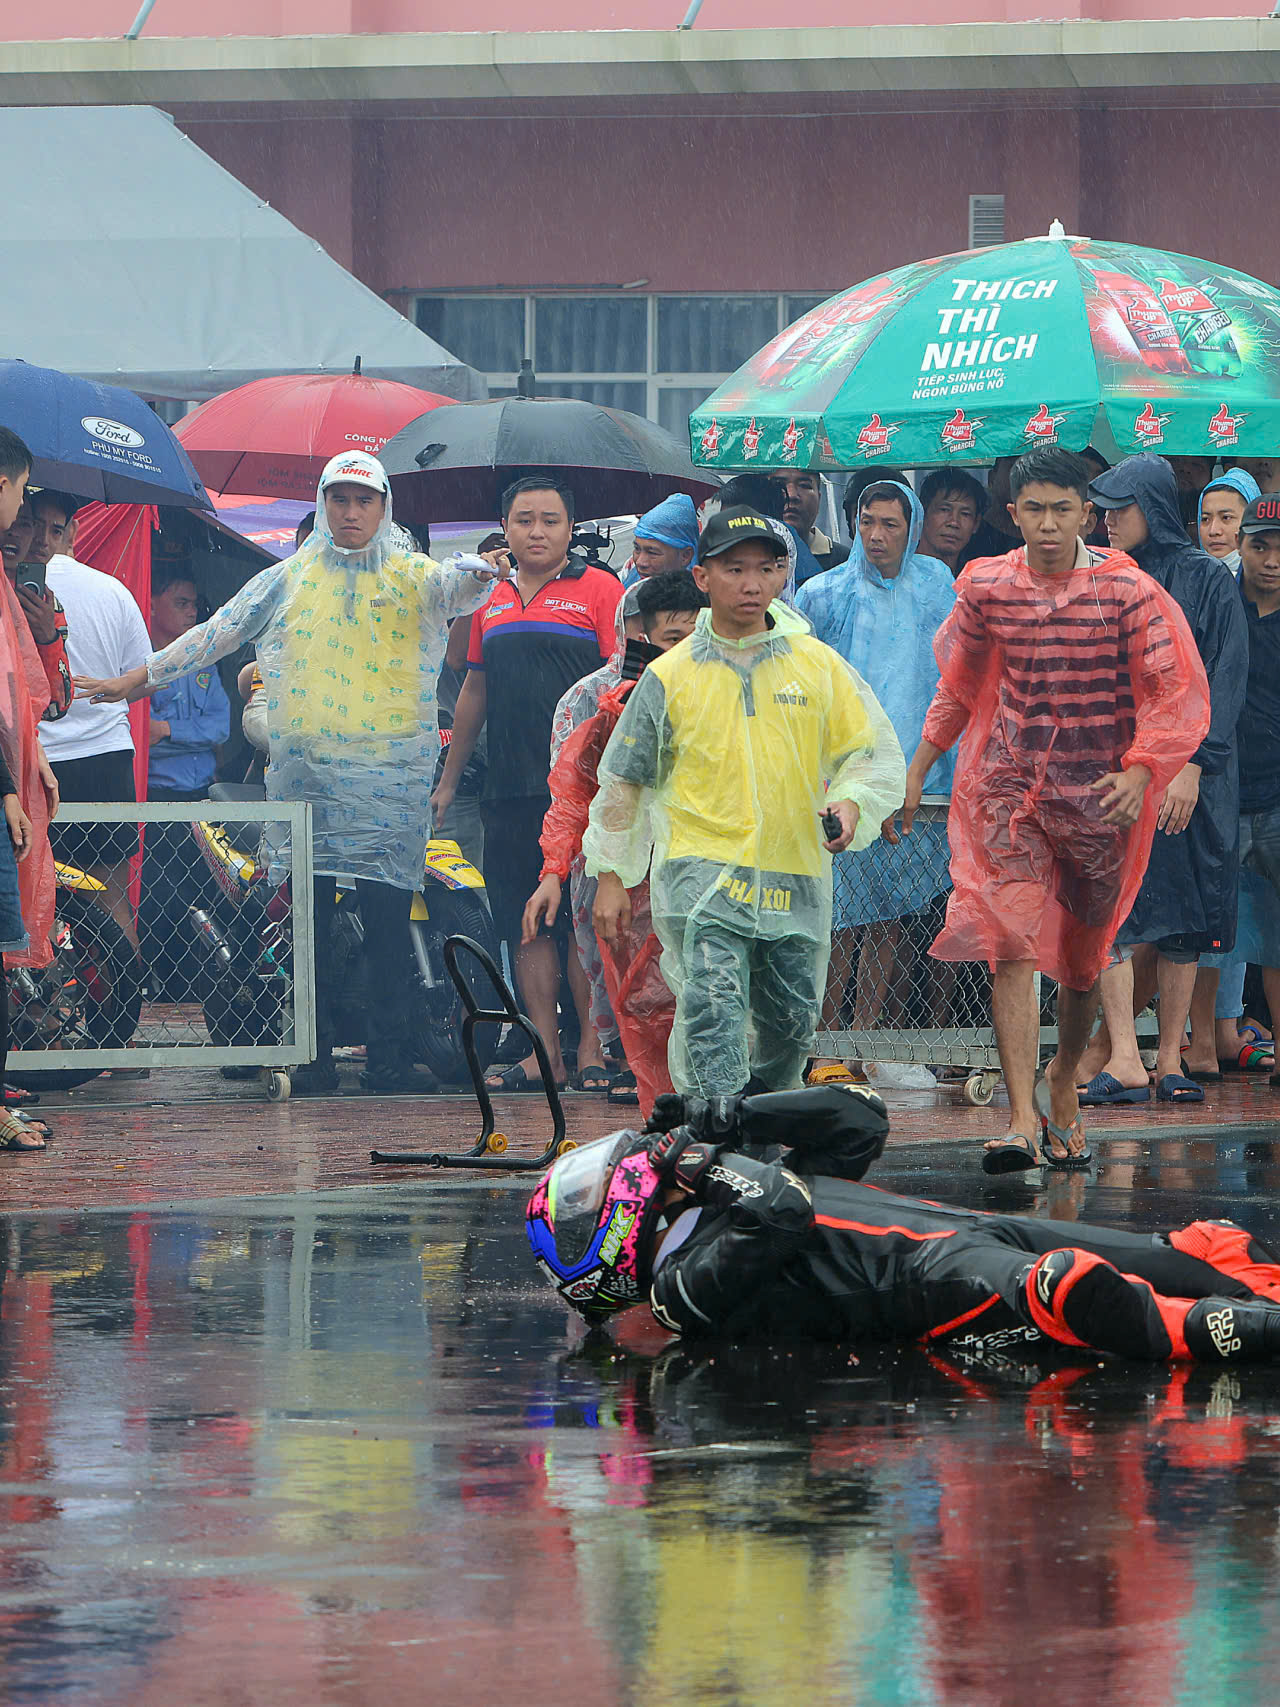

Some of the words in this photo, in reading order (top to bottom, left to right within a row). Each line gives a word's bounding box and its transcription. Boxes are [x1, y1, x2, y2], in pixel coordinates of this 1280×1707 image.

[951, 277, 1058, 300] THÍCH
[1162, 290, 1199, 304] Thums
[1177, 296, 1195, 307] UP
[937, 302, 1002, 334] THÌ
[1194, 312, 1231, 344] CHARGED
[920, 332, 1039, 371] NHÍCH
[946, 370, 977, 384] SINH
[946, 424, 970, 433] Thums
[1029, 420, 1054, 428] Thums
[1143, 424, 1153, 432] UP
[95, 421, 132, 443] Ford
[344, 433, 376, 443] CÔNG
[862, 429, 887, 438] Thums
[869, 434, 880, 443] UP
[949, 439, 976, 453] CHARGED
[1032, 435, 1059, 448] CHARGED
[1142, 436, 1164, 448] CHARGED
[1216, 436, 1239, 449] CHARGED
[91, 441, 111, 453] PHU
[112, 446, 126, 457] MY
[127, 450, 153, 464] FORD
[864, 444, 892, 459] CHARGED
[728, 516, 752, 529] PHAT
[761, 887, 791, 912] XOI
[598, 1203, 635, 1267] NHK
